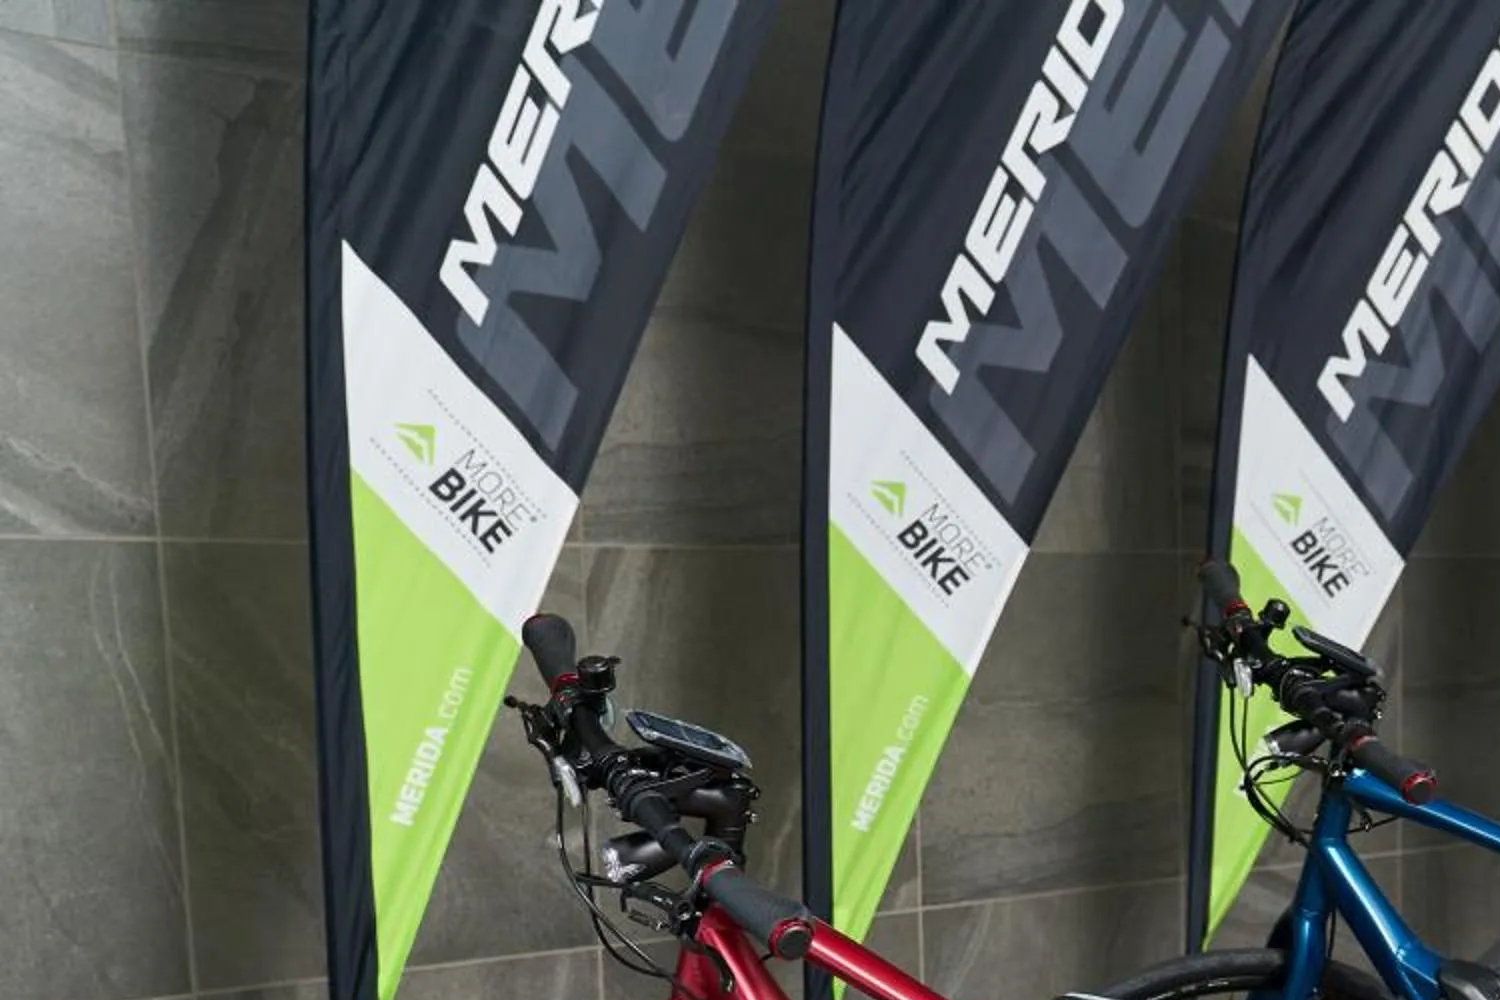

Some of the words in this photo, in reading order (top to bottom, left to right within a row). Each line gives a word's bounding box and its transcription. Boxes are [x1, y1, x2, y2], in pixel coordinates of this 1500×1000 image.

[428, 467, 513, 554] BIKE
[453, 448, 532, 531] MORE
[897, 519, 971, 596] BIKE
[920, 502, 984, 577] MORE
[1290, 529, 1350, 598] BIKE
[1313, 516, 1367, 581] MORE
